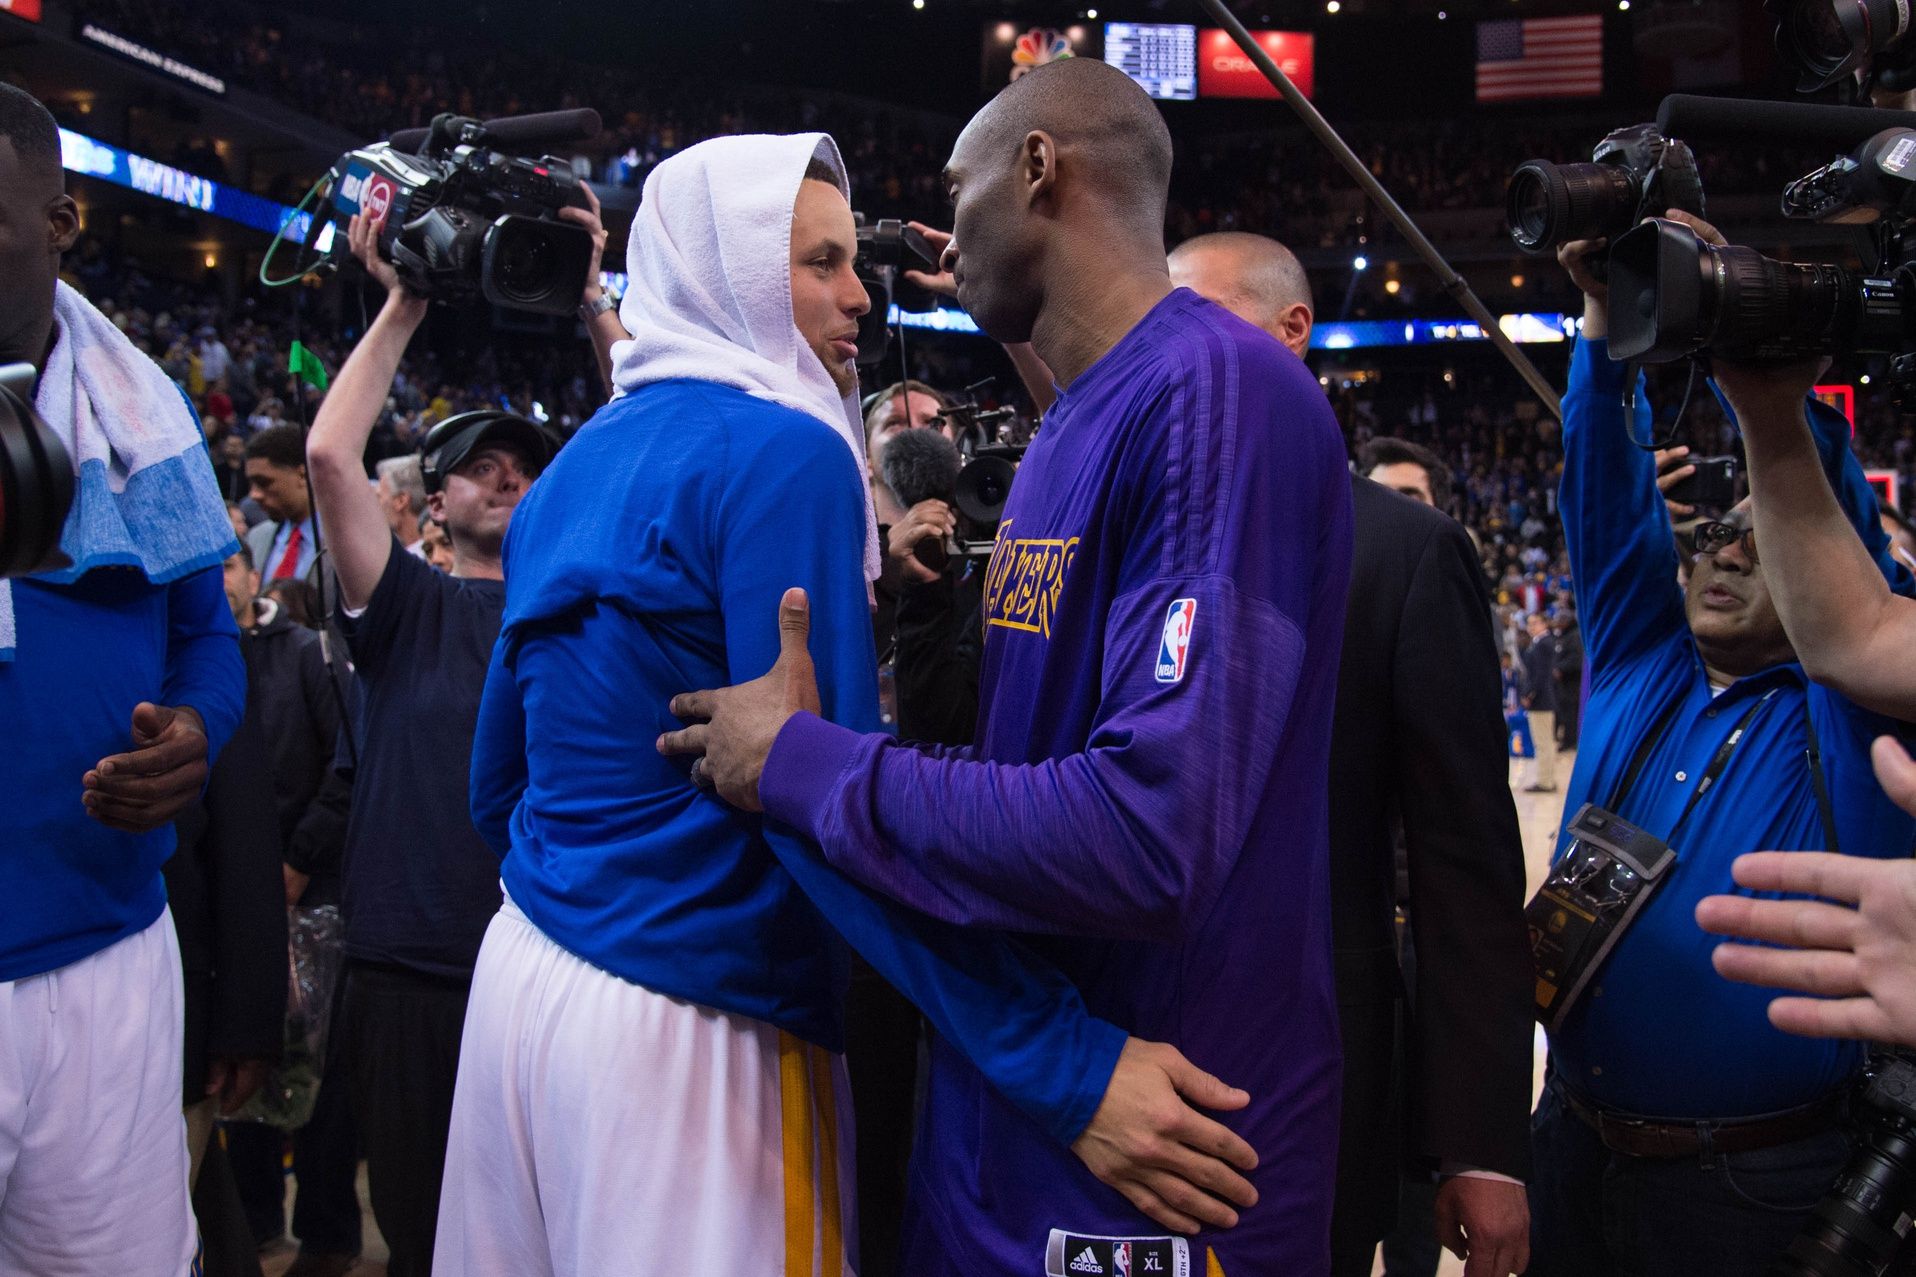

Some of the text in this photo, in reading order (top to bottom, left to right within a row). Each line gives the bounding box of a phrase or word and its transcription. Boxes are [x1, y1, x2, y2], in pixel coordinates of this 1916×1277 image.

[1212, 56, 1298, 74] ORAE
[1158, 664, 1174, 677] NBA
[1070, 1261, 1103, 1273] adidas
[1144, 1257, 1163, 1271] XL
